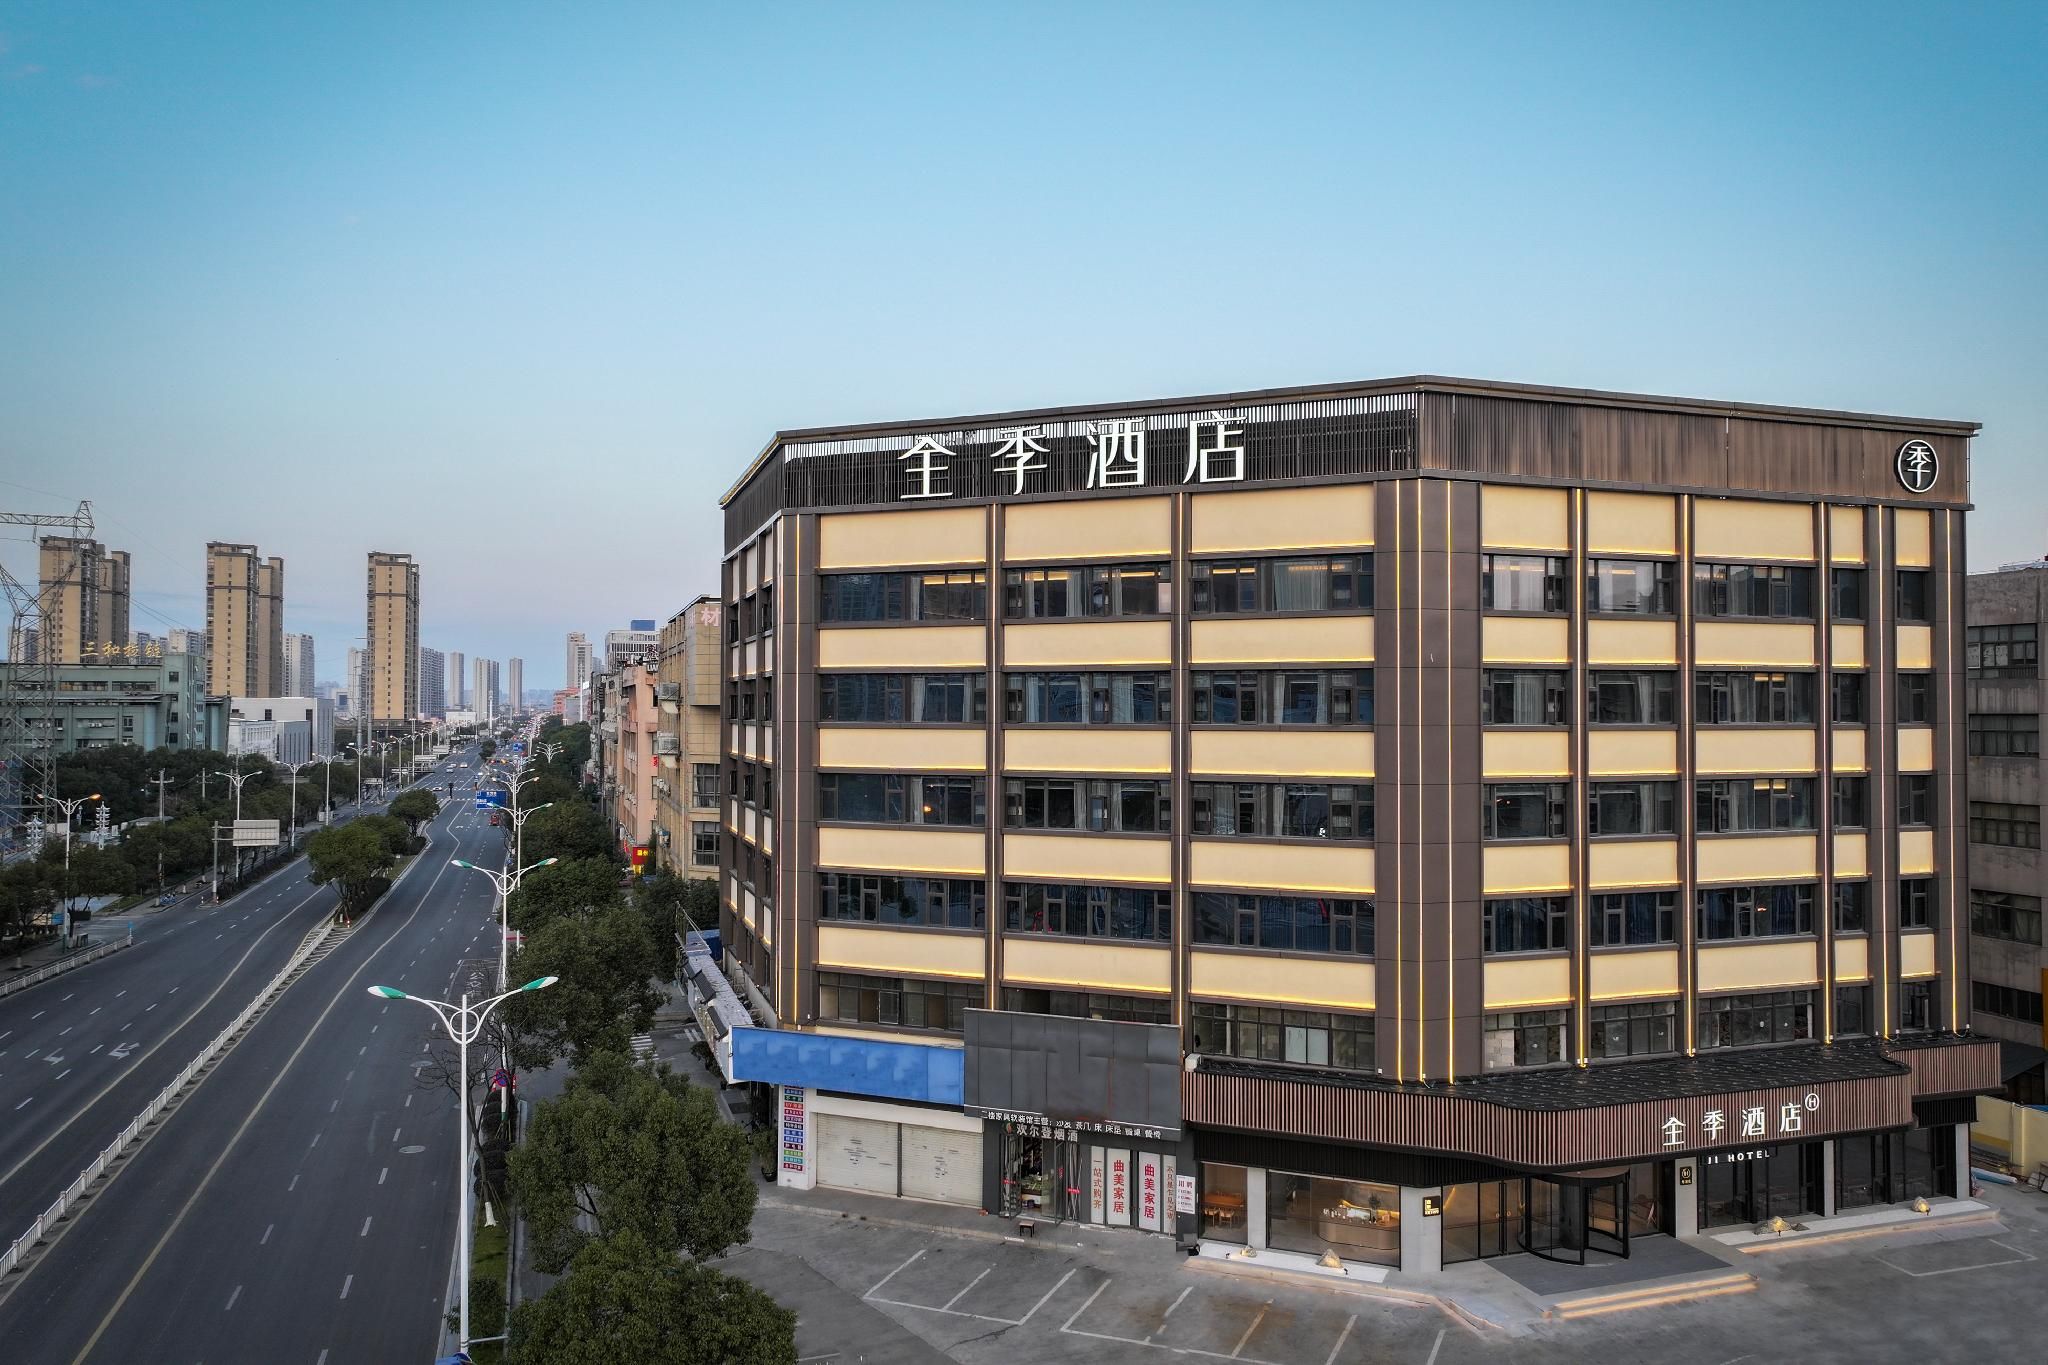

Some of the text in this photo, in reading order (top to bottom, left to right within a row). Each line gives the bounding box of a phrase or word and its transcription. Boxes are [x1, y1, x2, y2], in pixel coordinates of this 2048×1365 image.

[897, 410, 1248, 500] 全季酒店
[1906, 446, 1933, 488] 季
[1016, 1123, 1078, 1142] 欢尔登烟酒
[1661, 1102, 1802, 1146] 全季酒店
[1727, 1149, 1770, 1163] HOTEL
[1113, 1159, 1125, 1214] 曲美家居
[1144, 1164, 1156, 1219] 曲美家居
